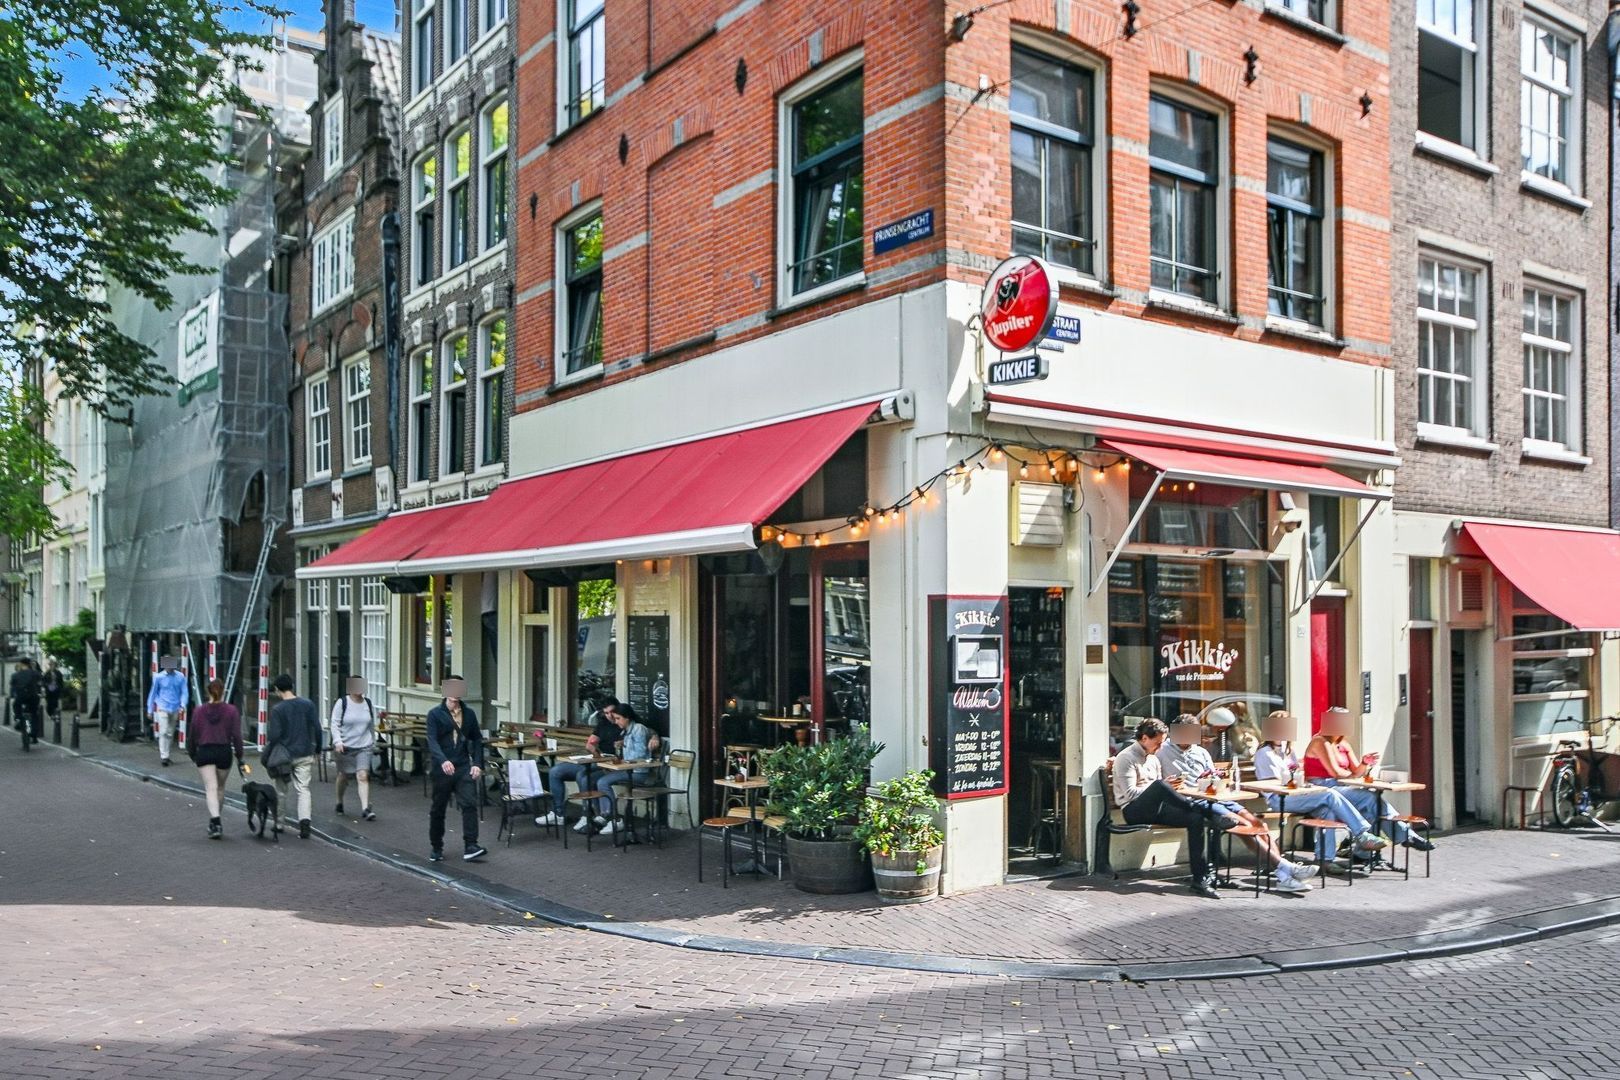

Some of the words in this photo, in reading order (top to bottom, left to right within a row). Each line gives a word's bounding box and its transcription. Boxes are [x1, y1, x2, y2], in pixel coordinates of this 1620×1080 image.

[908, 226, 930, 239] CENTRUM
[991, 315, 1034, 337] Jupiler
[1056, 329, 1079, 340] CENTRUM
[993, 359, 1036, 382] KIKKIE
